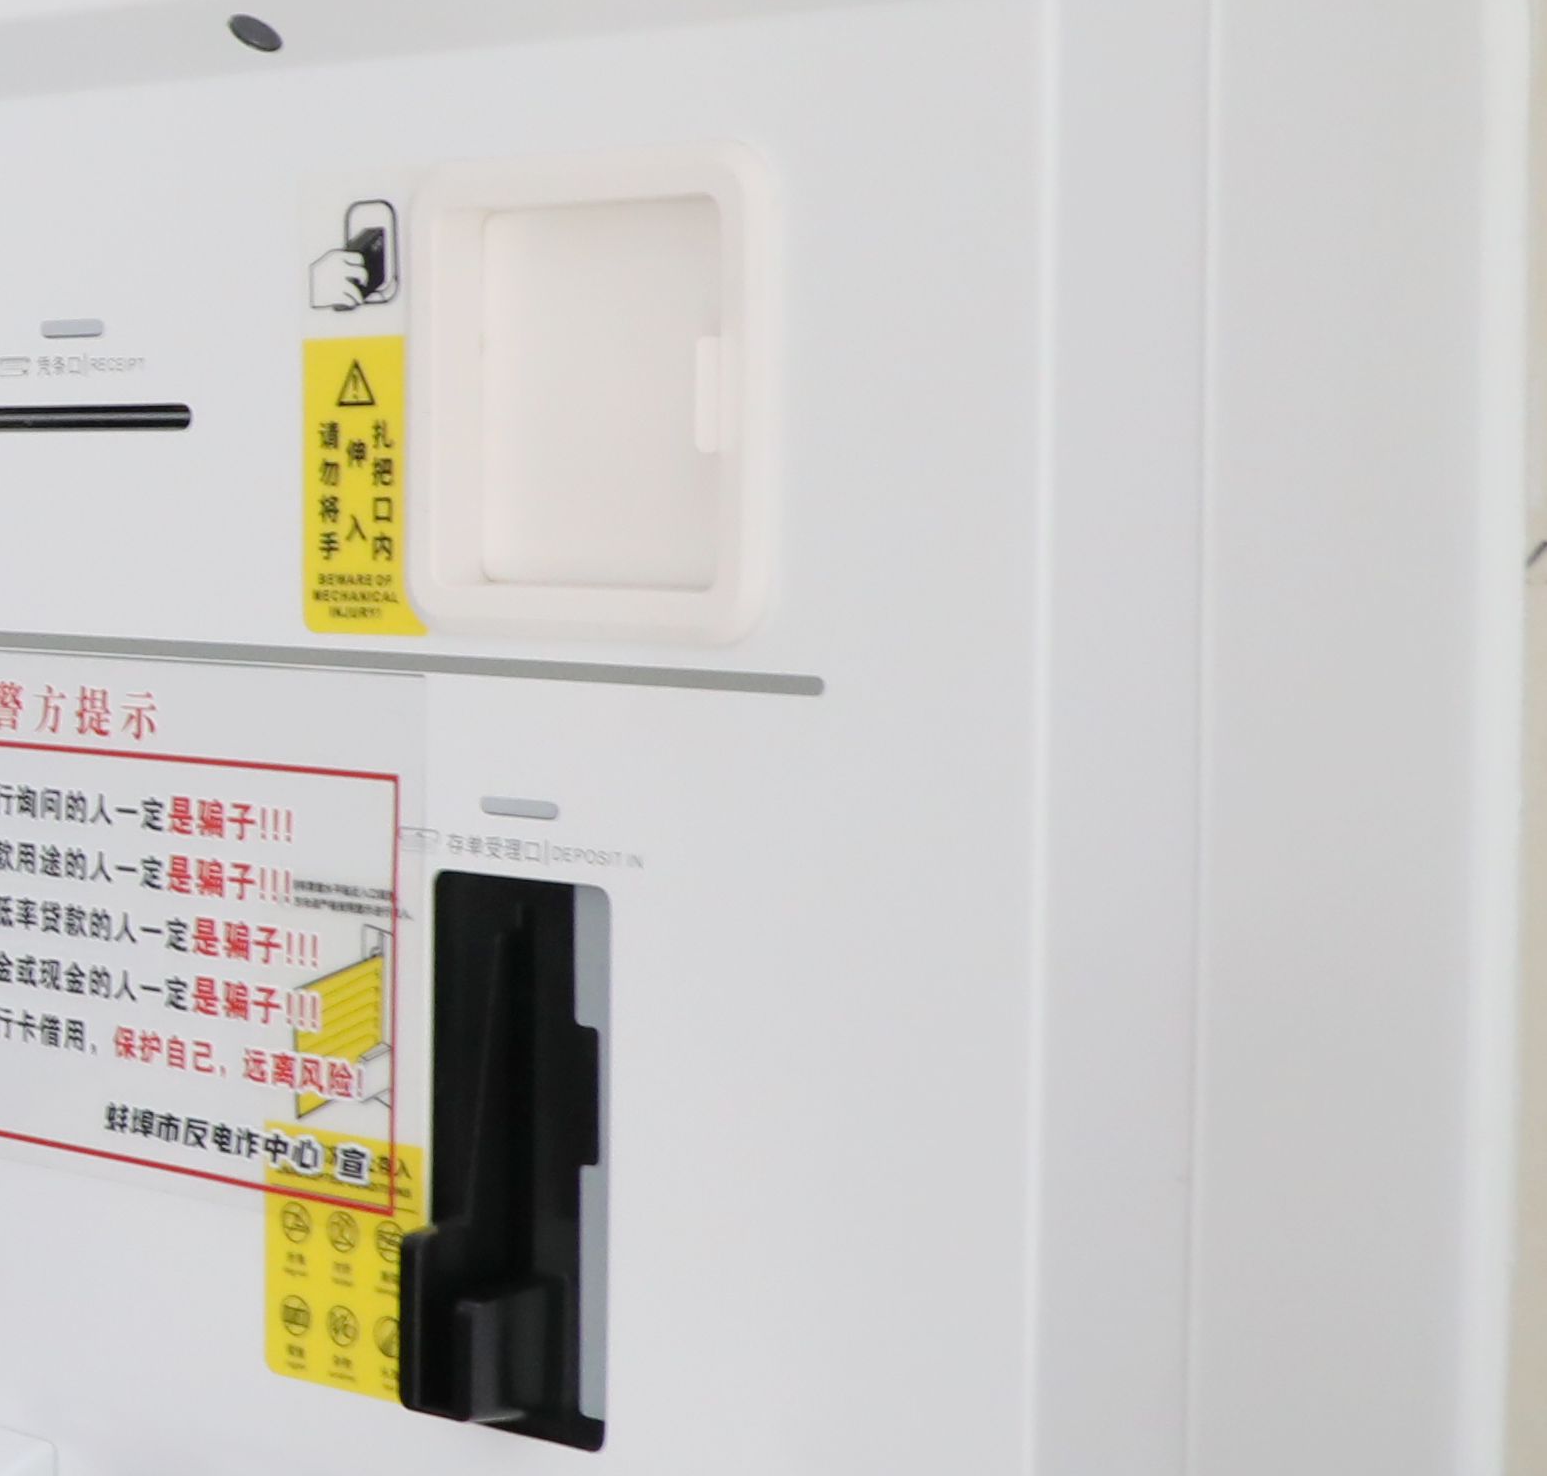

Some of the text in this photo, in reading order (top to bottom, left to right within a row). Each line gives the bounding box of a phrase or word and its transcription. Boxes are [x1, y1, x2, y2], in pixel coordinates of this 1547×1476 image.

[104, 1101, 319, 1171] 蚌埠市反电诈中心
